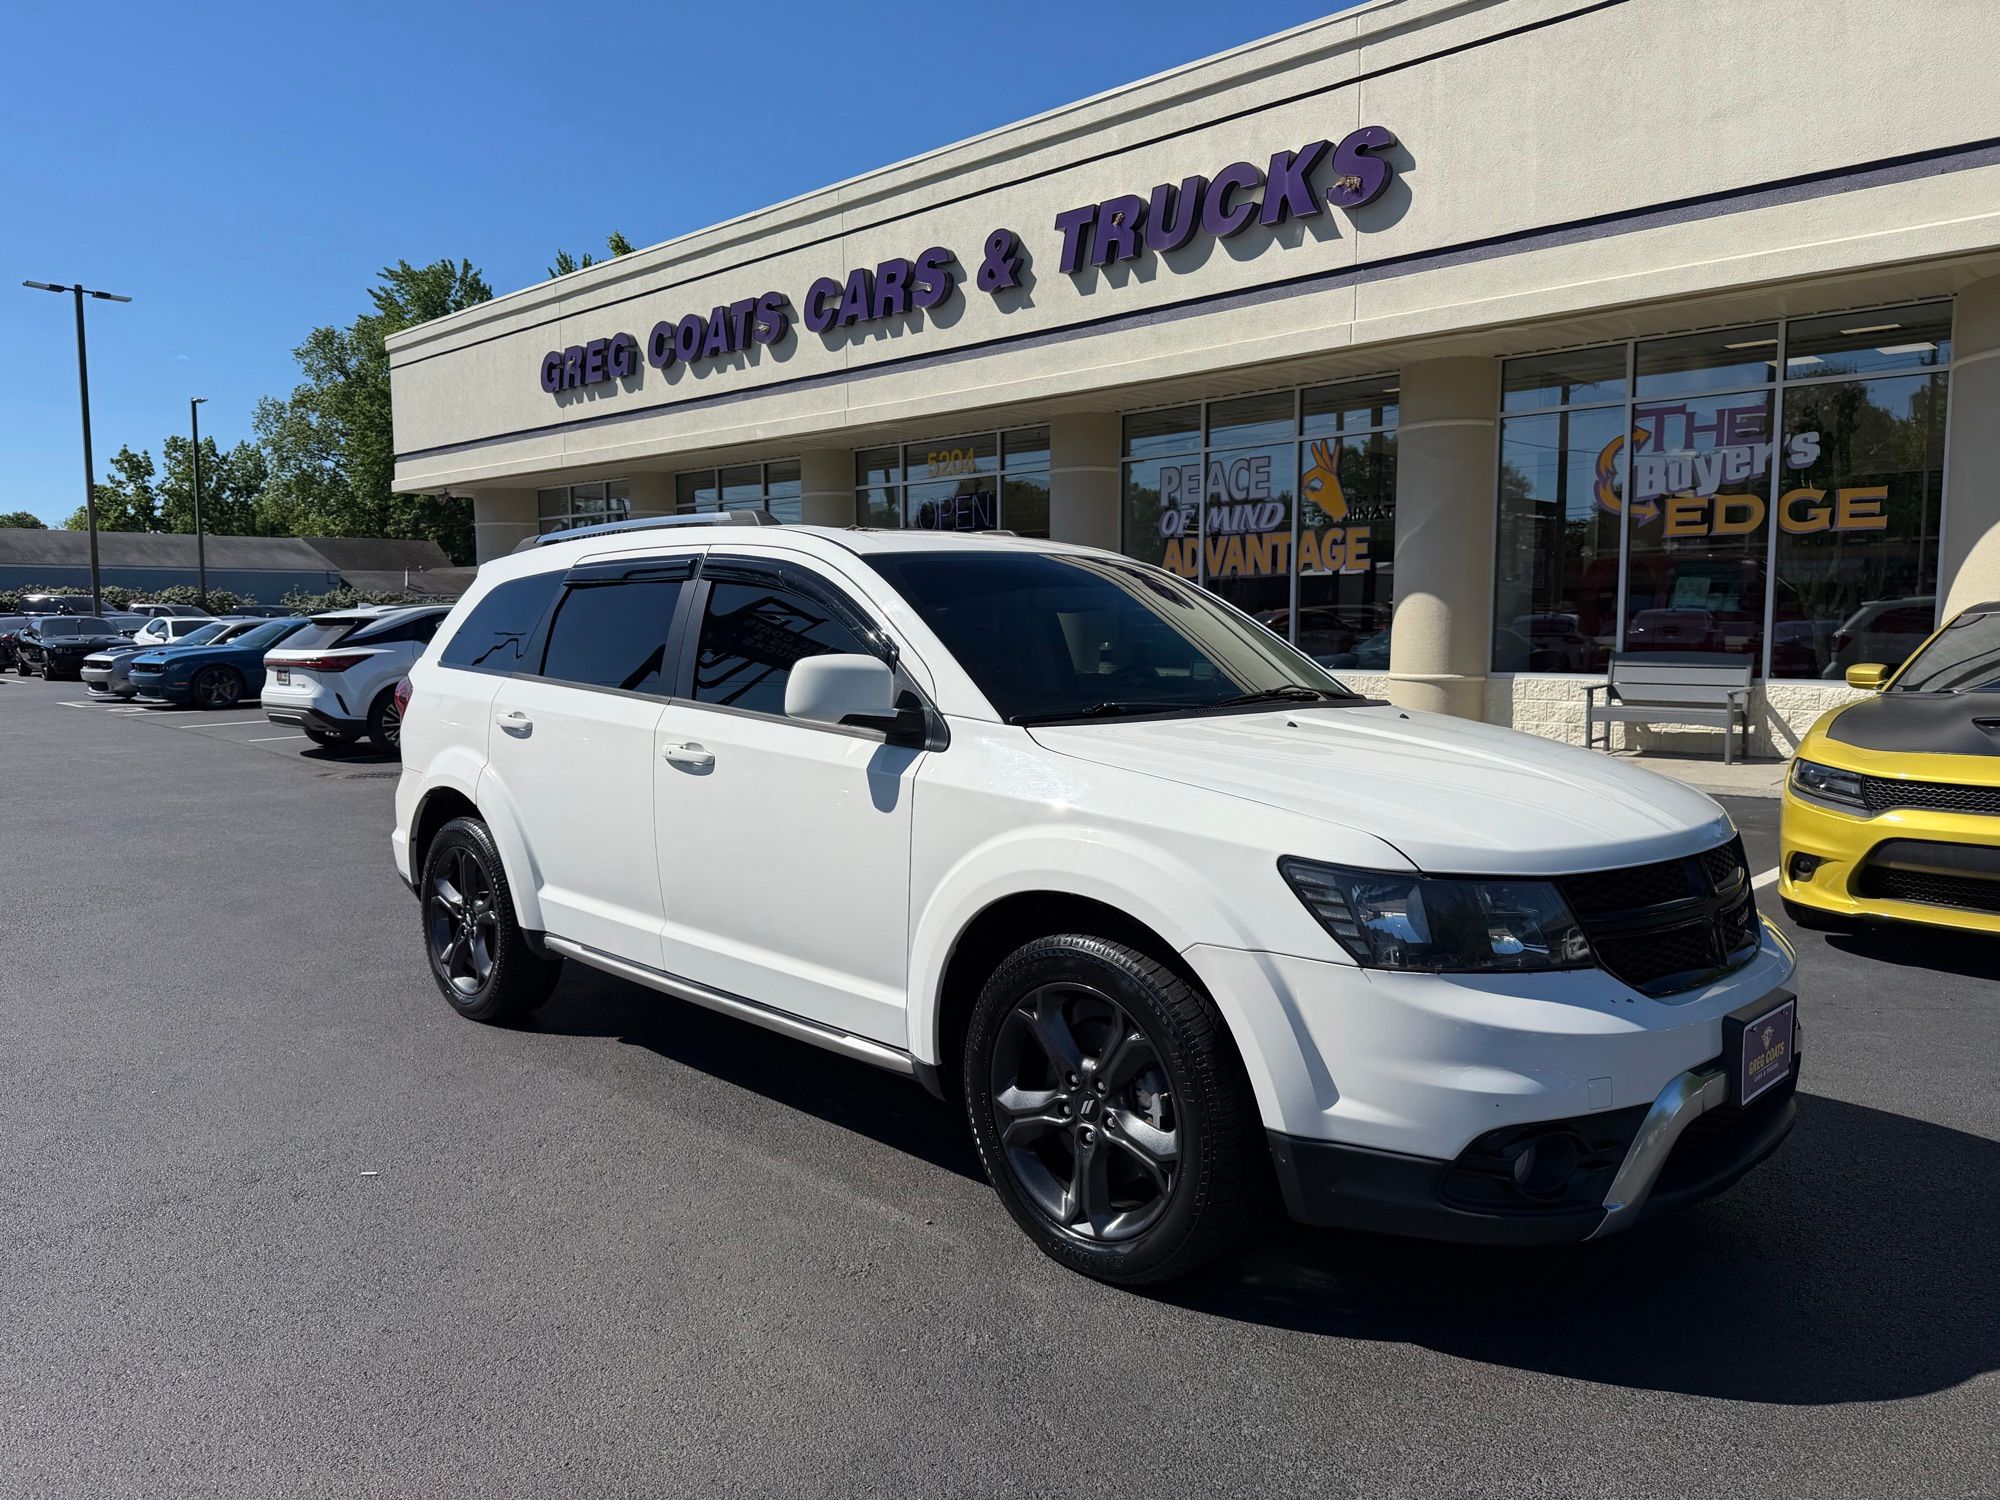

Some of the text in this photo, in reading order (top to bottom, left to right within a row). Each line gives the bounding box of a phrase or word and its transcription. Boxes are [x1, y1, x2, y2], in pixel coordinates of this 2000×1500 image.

[541, 125, 1397, 394] GREG COATS CARS & TRUCKS
[1636, 403, 1770, 455] THE
[927, 447, 976, 478] 5204
[1159, 455, 1272, 507] PEACE
[1631, 431, 1821, 500] Buyer's
[918, 490, 991, 530] OPEN
[1159, 500, 1287, 537] OF MIND
[1662, 484, 1889, 538] EDGE
[1162, 526, 1372, 579] ADVANTAGE
